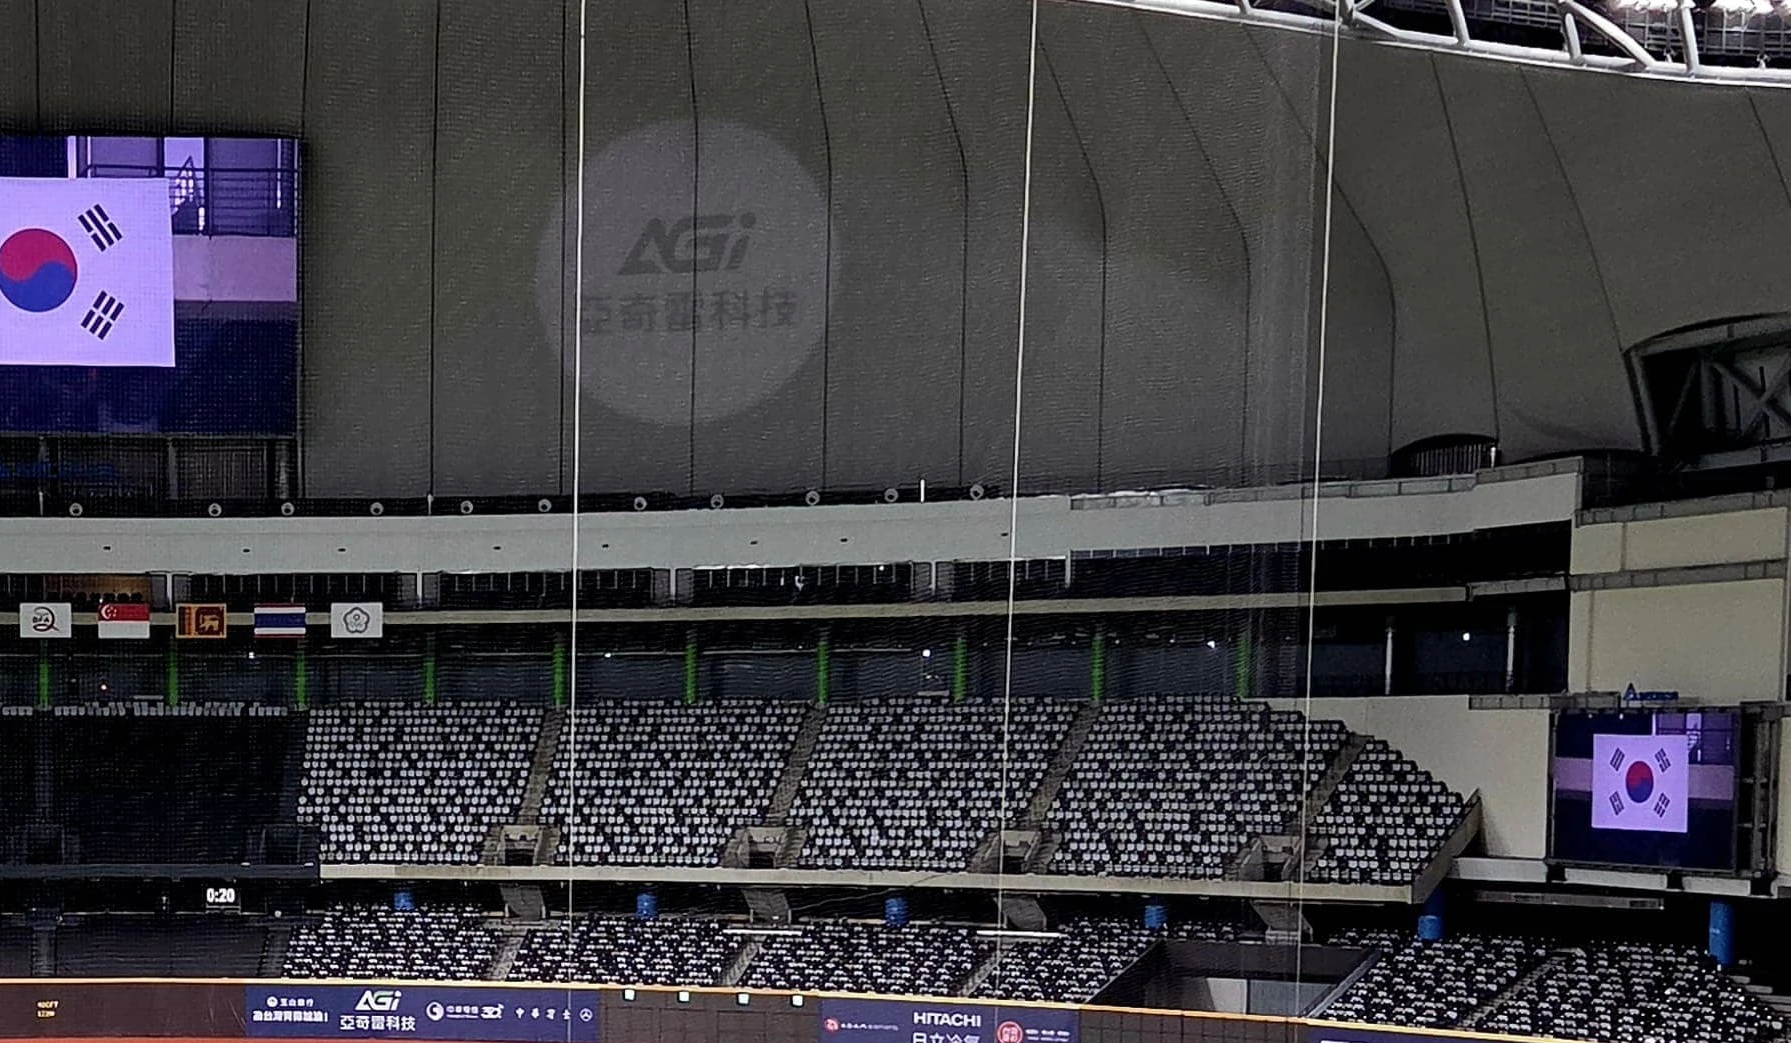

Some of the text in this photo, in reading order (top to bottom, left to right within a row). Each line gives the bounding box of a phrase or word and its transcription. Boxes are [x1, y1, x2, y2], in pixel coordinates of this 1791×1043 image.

[206, 888, 235, 903] 0:20
[340, 1015, 416, 1031] 亞奇雷科技
[913, 1012, 981, 1027] HITACHI
